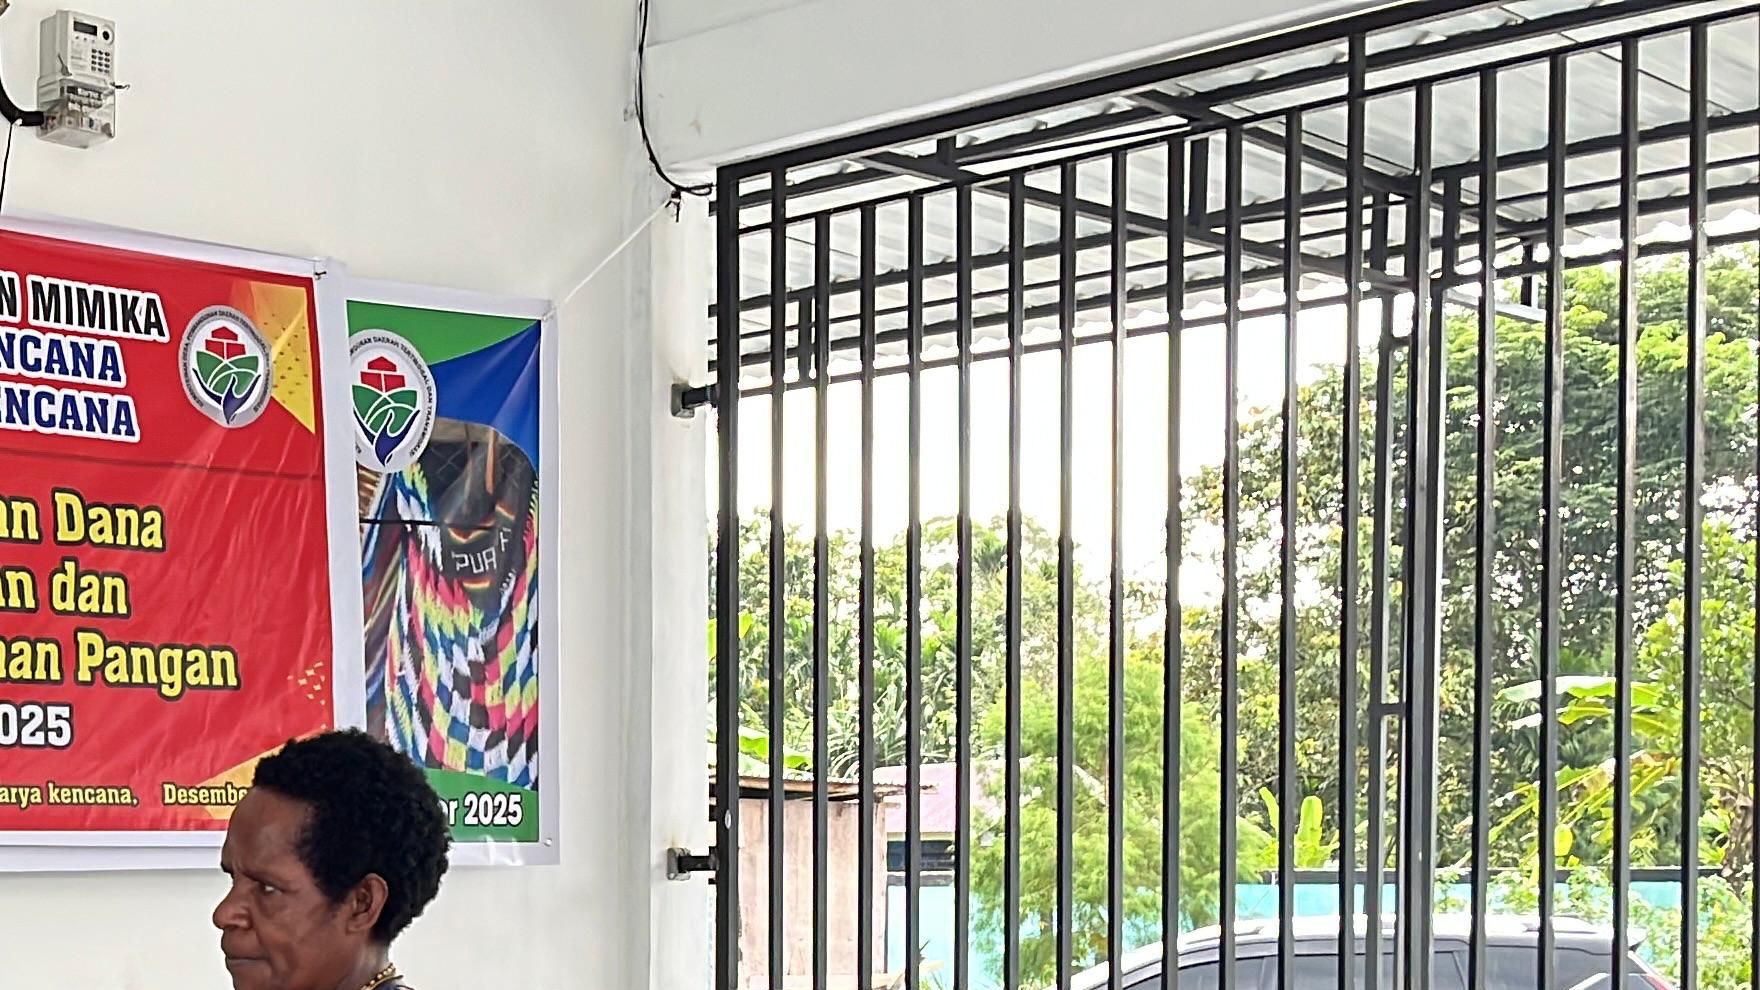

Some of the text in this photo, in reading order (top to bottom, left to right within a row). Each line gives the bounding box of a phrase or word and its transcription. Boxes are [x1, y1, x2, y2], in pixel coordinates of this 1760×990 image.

[31, 279, 166, 337] MIMIKA
[53, 491, 164, 549] Dana
[51, 560, 128, 615] dan
[76, 631, 238, 698] Pangan
[48, 782, 138, 806] kencana,
[464, 793, 523, 826] 2025
